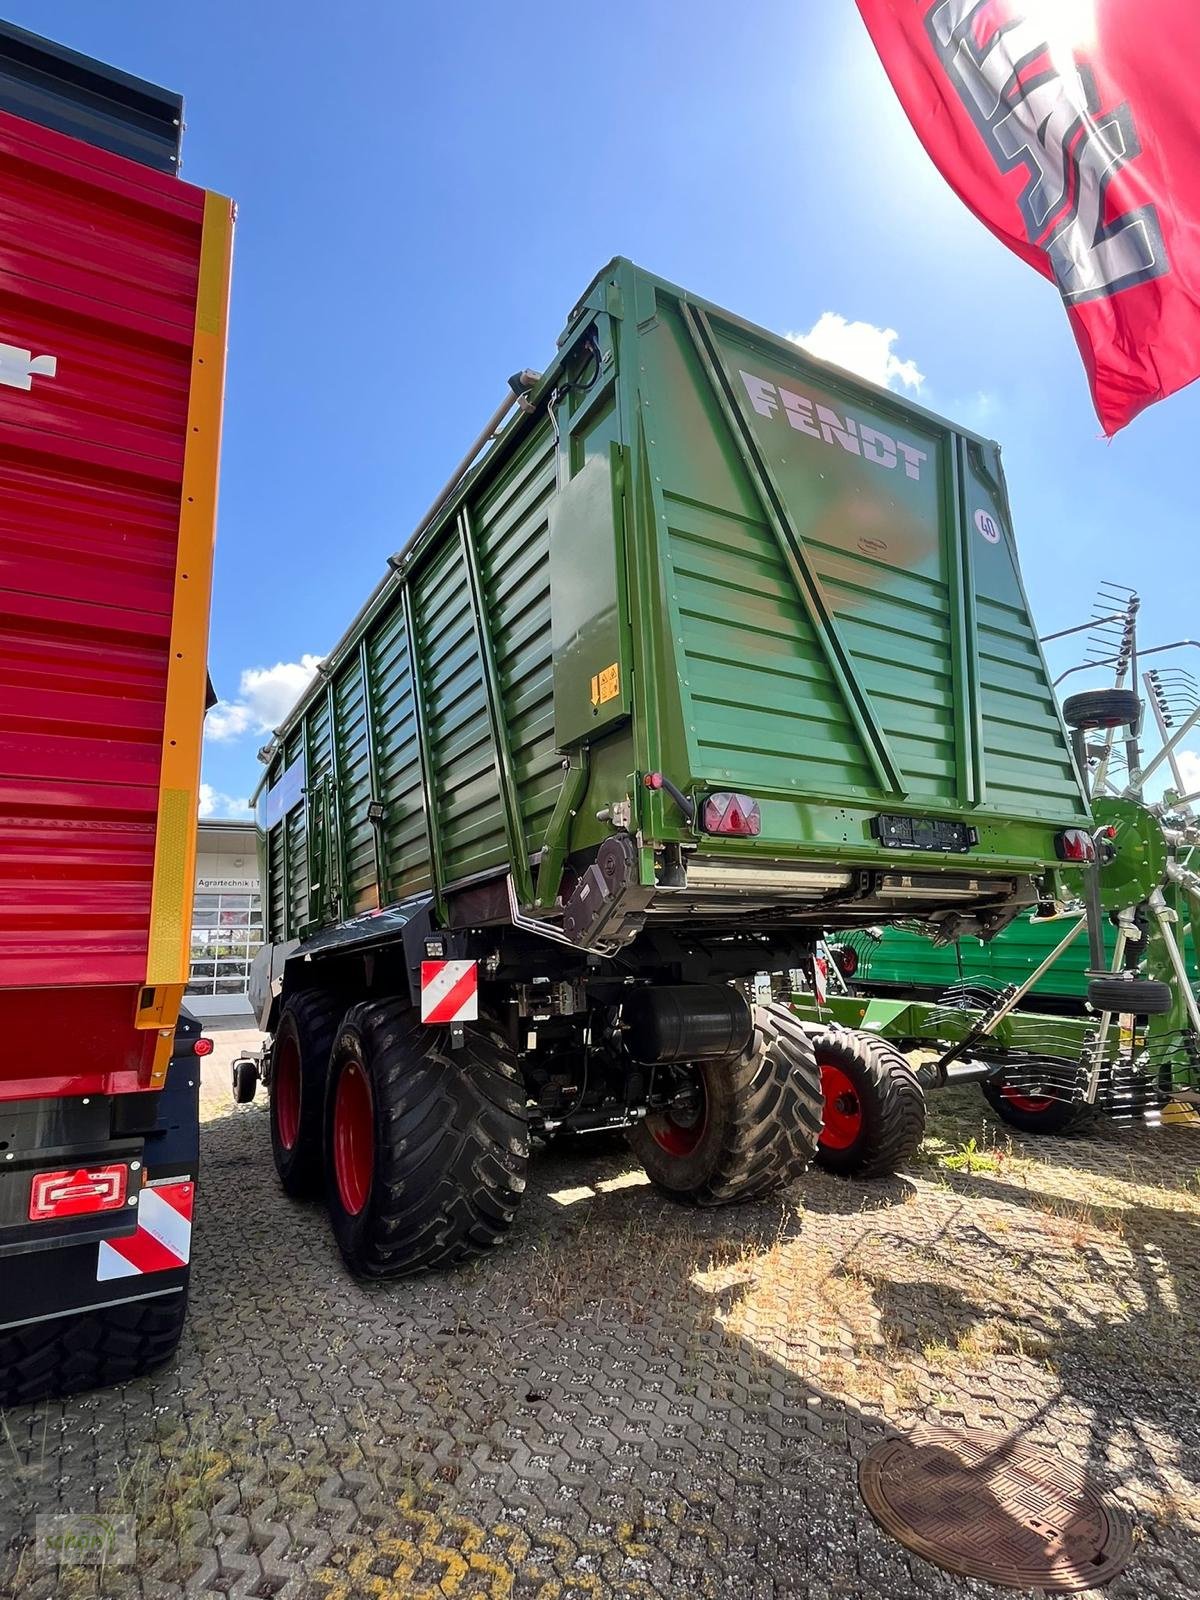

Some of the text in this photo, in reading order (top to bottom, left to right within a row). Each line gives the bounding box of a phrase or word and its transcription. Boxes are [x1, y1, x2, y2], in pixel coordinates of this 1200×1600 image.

[739, 370, 927, 481] FENDT
[980, 514, 997, 538] 40
[198, 879, 249, 888] Agrartechnik
